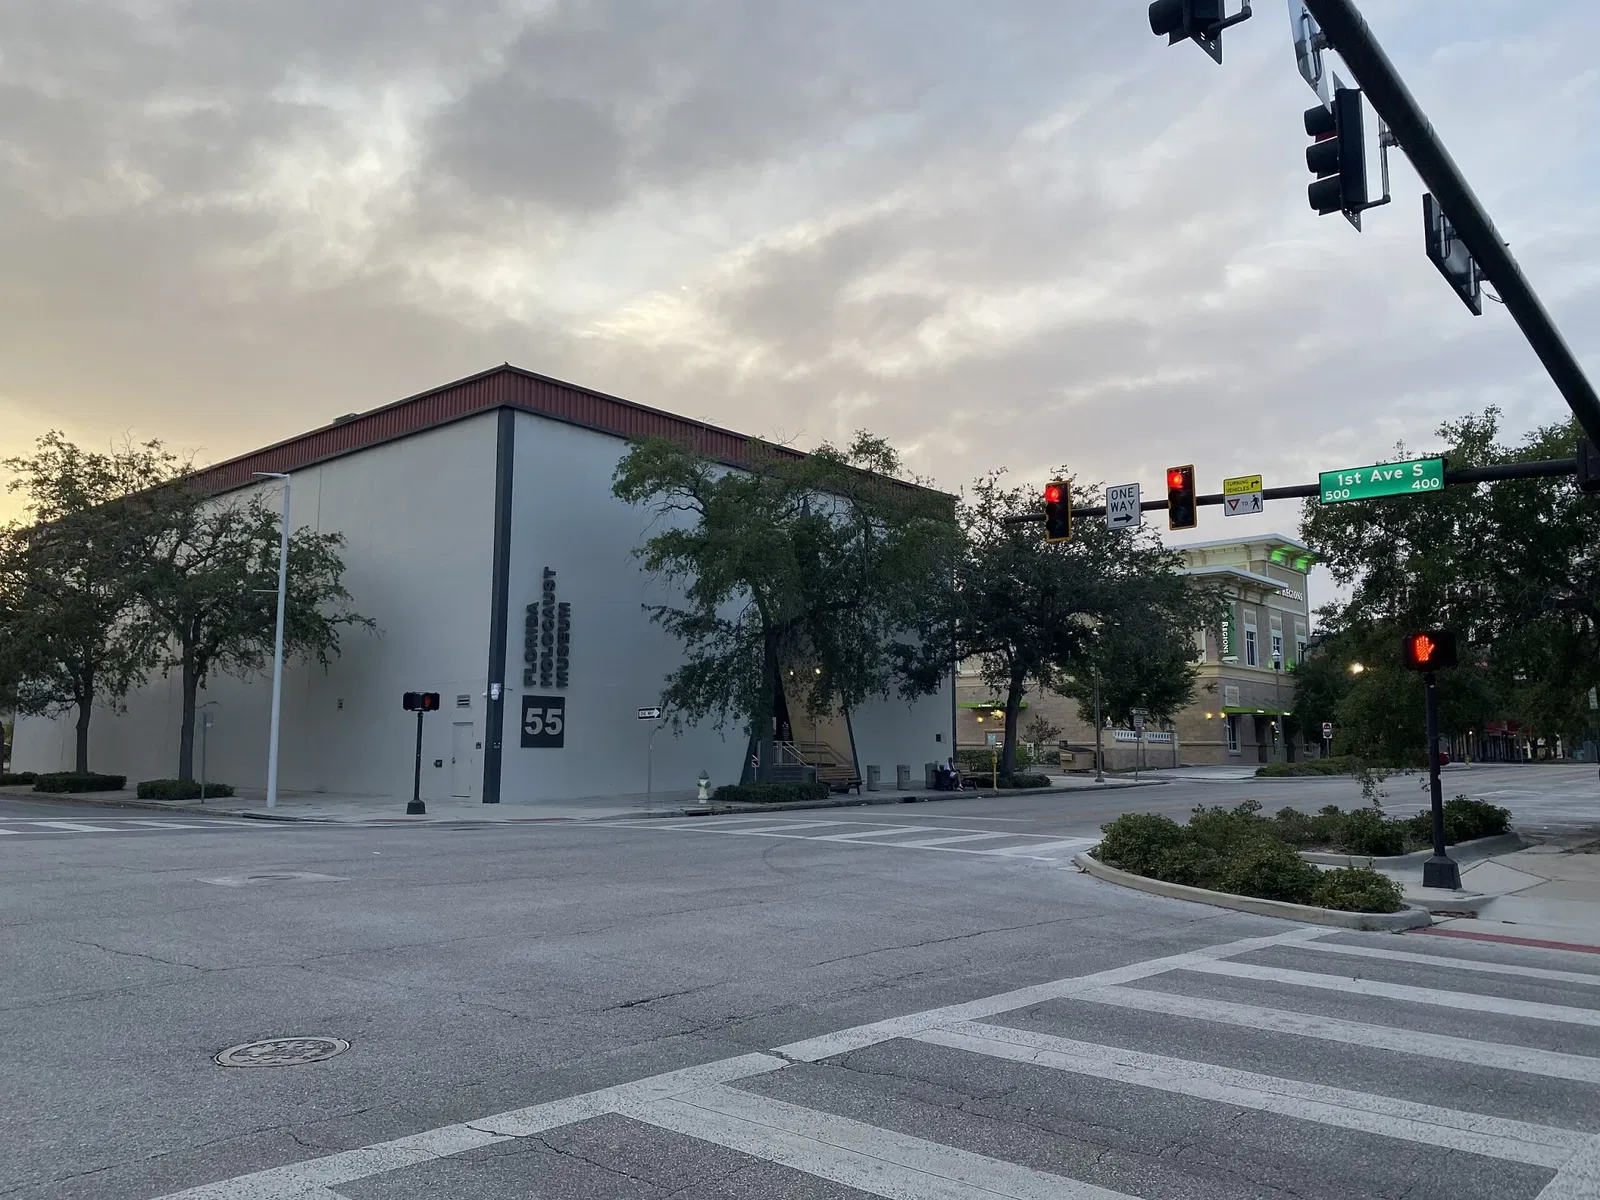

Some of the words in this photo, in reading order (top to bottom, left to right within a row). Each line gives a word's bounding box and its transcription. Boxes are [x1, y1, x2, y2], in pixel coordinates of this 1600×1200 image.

[1226, 479, 1249, 487] TURNING
[1338, 472, 1361, 486] 1st
[1370, 469, 1403, 482] Ave
[1412, 463, 1423, 476] S
[1411, 478, 1439, 489] 400
[1111, 487, 1135, 500] ONE
[1325, 489, 1350, 500] 500
[1110, 499, 1136, 512] WAY
[540, 566, 557, 687] HOLOCAUST
[1221, 621, 1229, 654] REGIONS
[524, 601, 540, 687] FLORIDA
[556, 602, 571, 688] MUSEUM
[524, 707, 563, 736] 55
